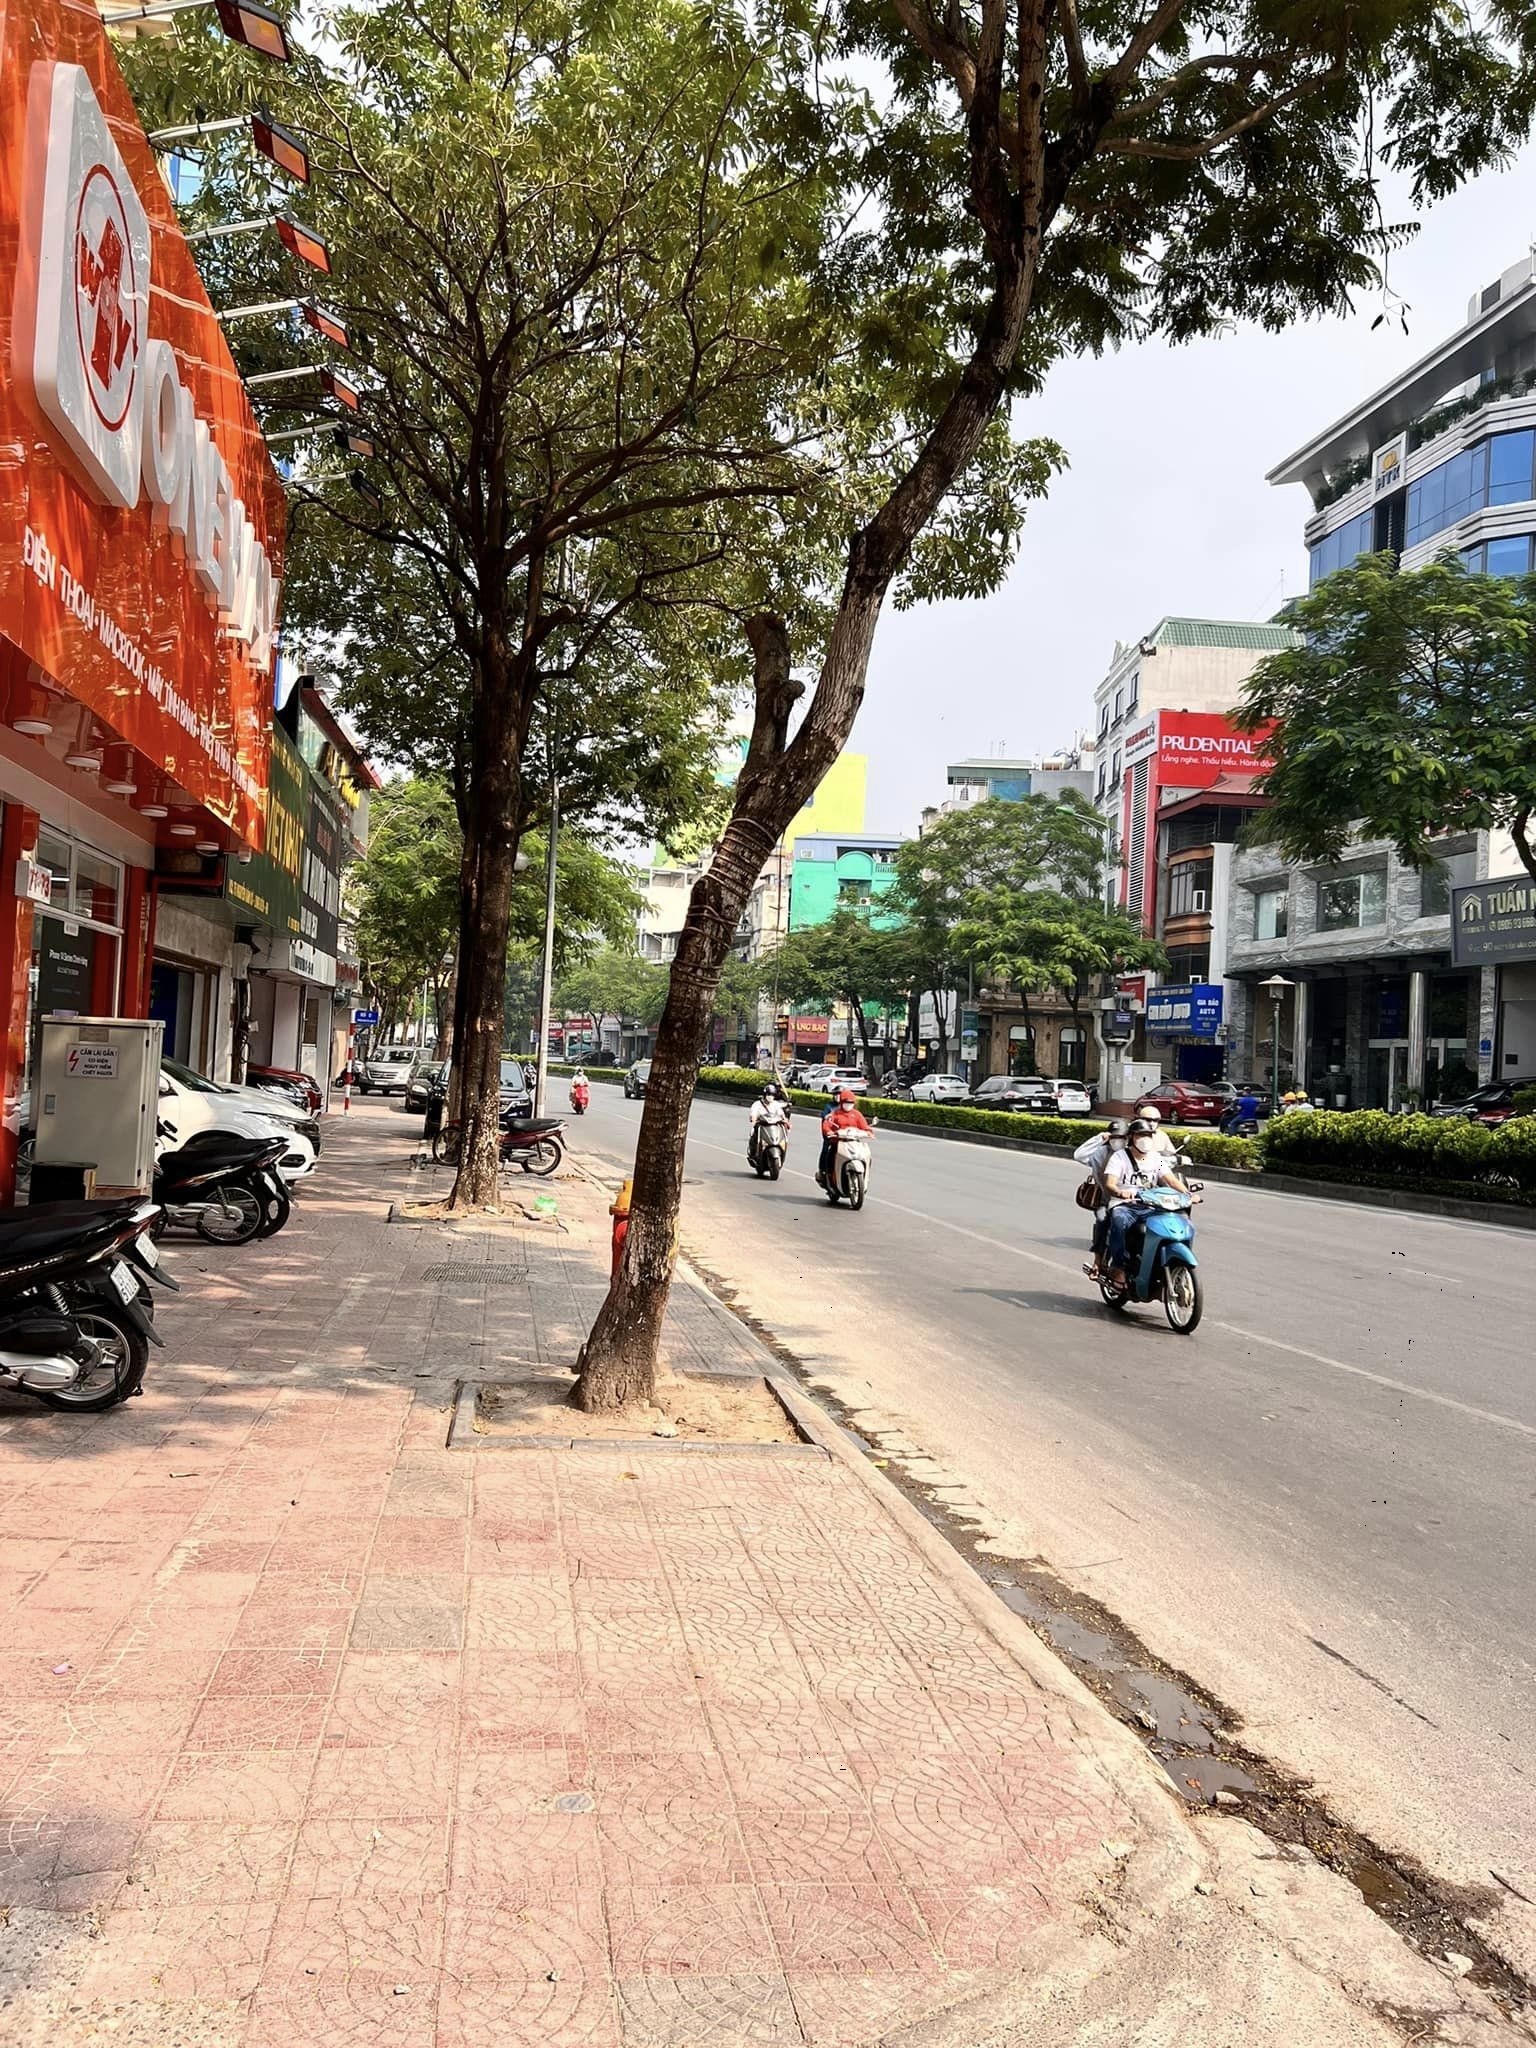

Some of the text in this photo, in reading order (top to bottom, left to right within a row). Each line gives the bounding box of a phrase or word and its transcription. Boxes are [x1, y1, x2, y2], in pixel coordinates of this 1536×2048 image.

[24, 524, 56, 591] ĐIỆN
[60, 564, 95, 632] THOẠI
[100, 608, 145, 684] MACBOOK
[1161, 735, 1255, 754] PRUDENTIAL
[1202, 755, 1220, 765] Thấu
[1240, 758, 1259, 767] Hành
[1487, 883, 1526, 914] TUẤN
